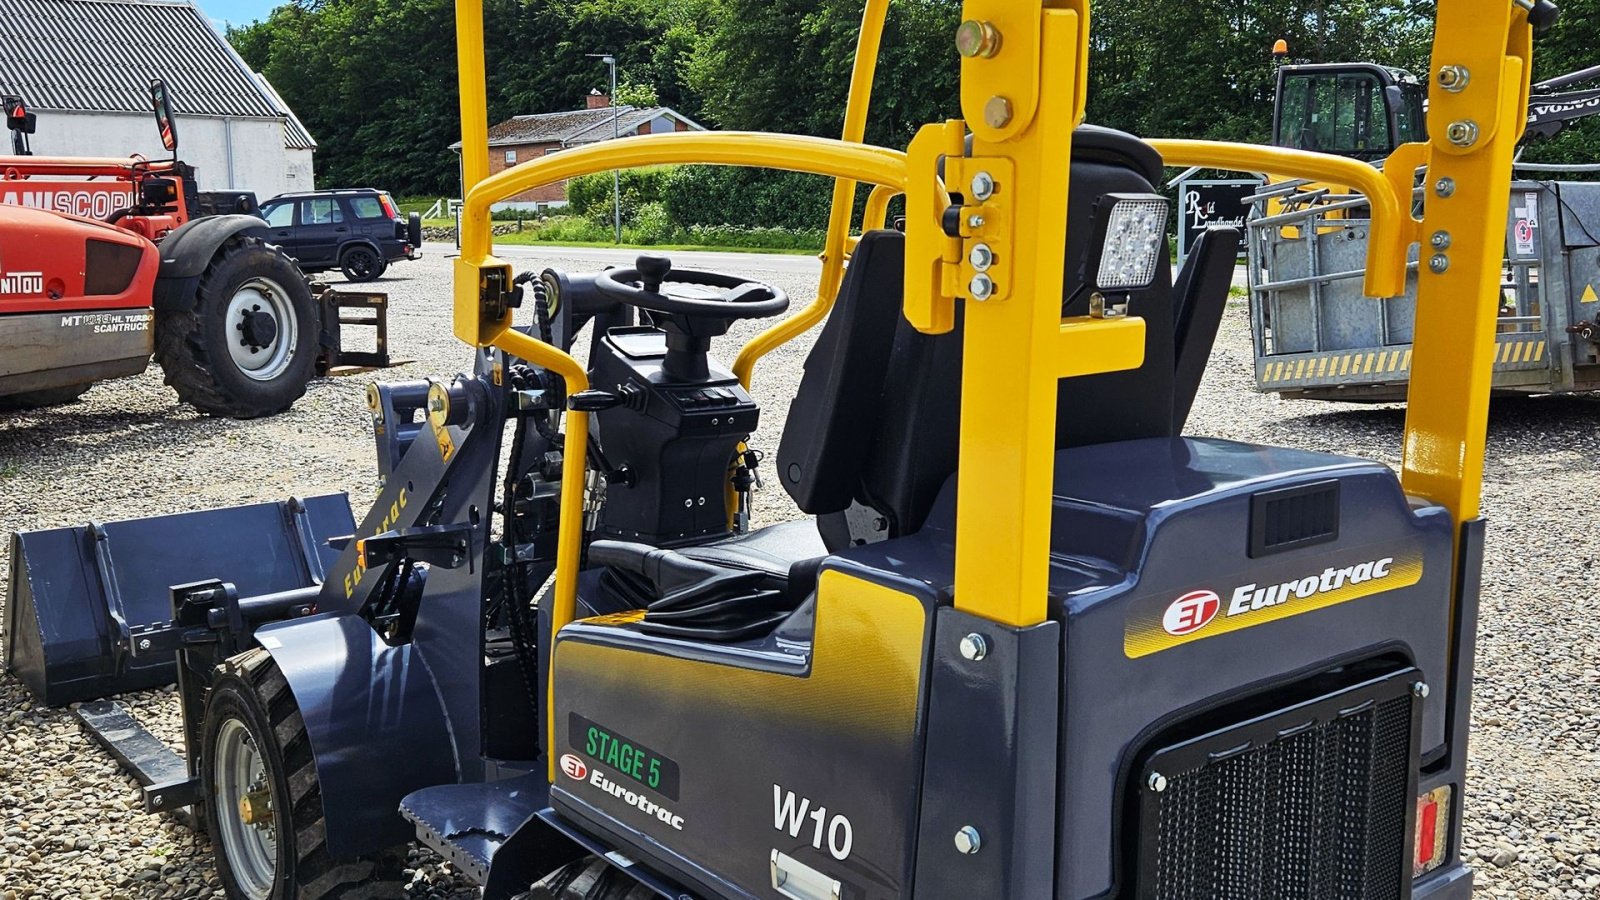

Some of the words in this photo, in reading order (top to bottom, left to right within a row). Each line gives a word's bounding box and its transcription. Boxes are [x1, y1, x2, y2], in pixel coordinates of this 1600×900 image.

[1534, 98, 1600, 115] VOLVO
[0, 271, 43, 294] NITOU
[61, 315, 82, 327] MT
[111, 315, 124, 323] HL
[125, 314, 153, 322] TURBO
[93, 322, 149, 333] SCANTRUCK
[344, 487, 407, 599] Eurac
[1226, 557, 1393, 617] Eurotrac
[586, 727, 646, 780] STAGE
[648, 759, 661, 788] 5
[590, 769, 685, 831] Eurotrac
[773, 784, 853, 861] W10
